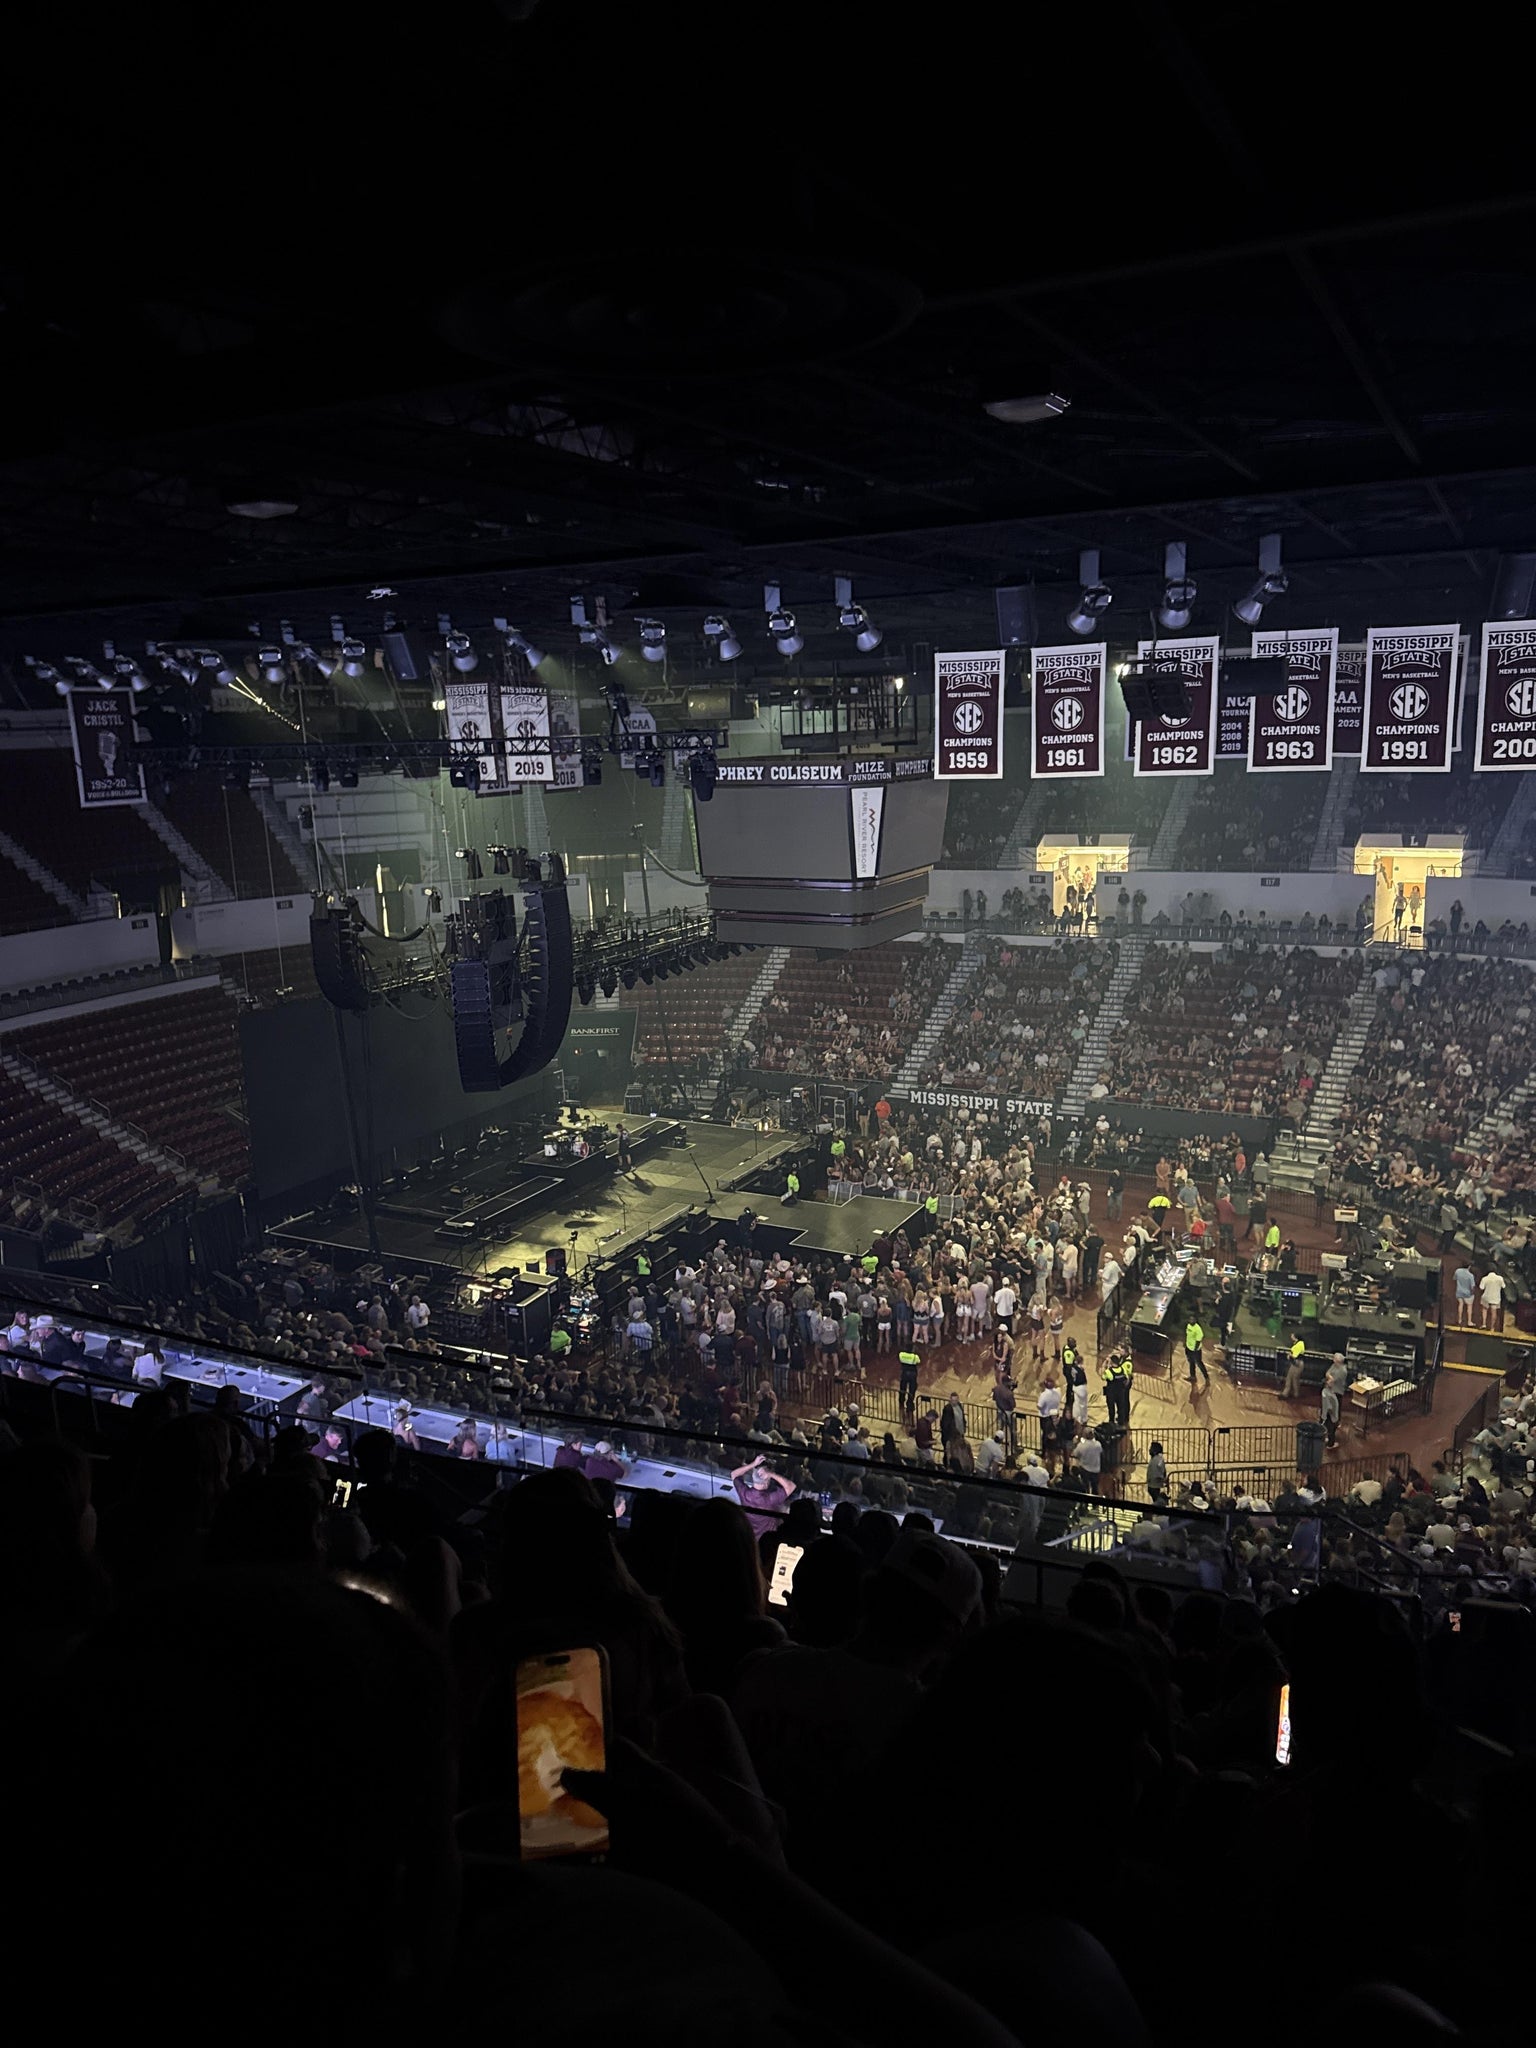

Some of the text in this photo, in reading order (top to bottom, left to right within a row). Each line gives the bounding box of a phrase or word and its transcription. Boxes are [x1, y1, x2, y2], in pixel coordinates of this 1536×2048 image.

[1372, 636, 1454, 650] MISSISSIPPI
[1488, 632, 1536, 645] MISSIS
[1257, 640, 1332, 654] MISSISSIPPI
[1510, 646, 1536, 659] STAT
[1036, 654, 1102, 668] MISSISSIPPI
[1289, 655, 1310, 666] ATE
[1393, 652, 1430, 664] STATE
[939, 661, 1000, 672] MISSISSIPPI
[1336, 664, 1353, 672] ATE
[955, 674, 983, 684] STATE
[1052, 668, 1082, 680] STATE
[446, 686, 488, 696] MISSISSIPPI
[1508, 680, 1536, 715] SE
[88, 700, 118, 712] JACK
[1276, 687, 1308, 720] SEC
[1392, 685, 1427, 719] SEC
[84, 715, 124, 726] CRISTIL
[955, 703, 982, 733] SEC
[1054, 698, 1082, 730] SEC
[1338, 720, 1360, 728] 2025
[1376, 725, 1440, 735] CHAMPIONS
[1491, 722, 1536, 732] CHAMPI
[1147, 730, 1204, 742] CHAMPIONS
[1261, 726, 1320, 736] CHAMPIONS
[944, 738, 992, 747] CHAMPIONS
[1042, 734, 1094, 744] CHAMPIONS
[1152, 746, 1198, 764] 1962
[1266, 741, 1314, 760] 1963
[1381, 740, 1428, 760] 1991
[1492, 738, 1536, 759] 200
[948, 752, 988, 769] 1959
[1047, 748, 1085, 766] 1961
[515, 762, 544, 775] 2019
[717, 766, 842, 780] PHREY COLISEUM
[855, 761, 884, 774] MIZE
[896, 760, 929, 776] HUMPHREY
[554, 770, 576, 786] 2018
[848, 772, 892, 782] FOUNDATION
[1086, 836, 1092, 845] K
[1410, 836, 1418, 846] L
[910, 1090, 1053, 1116] MISSISSIPPI STATE
